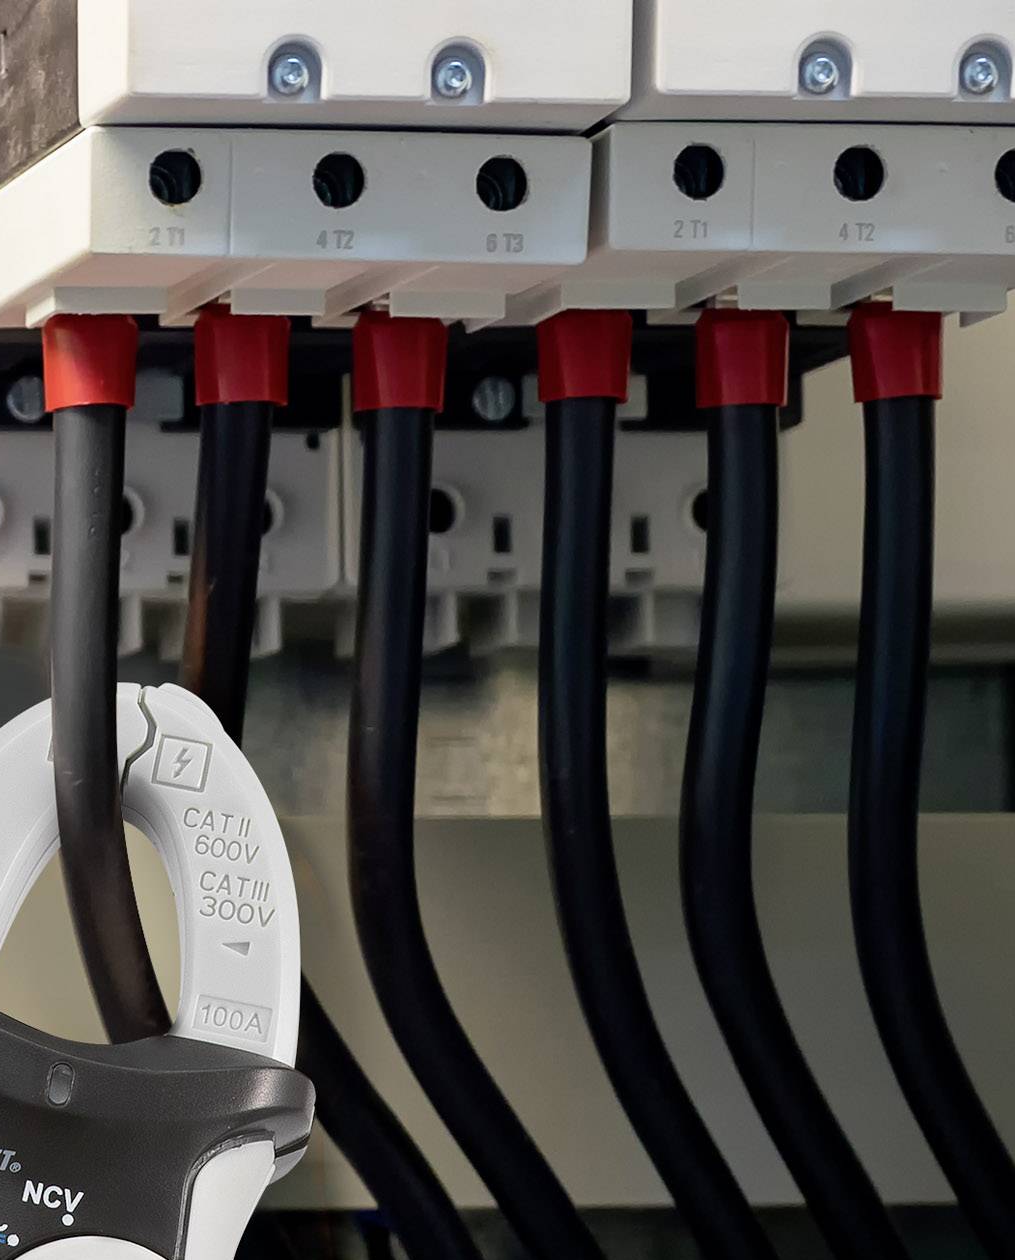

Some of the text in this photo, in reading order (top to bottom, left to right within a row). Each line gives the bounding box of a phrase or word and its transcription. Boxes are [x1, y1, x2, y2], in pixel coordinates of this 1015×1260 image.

[150, 227, 184, 247] 2 T1
[674, 220, 708, 239] 2 T1
[839, 223, 875, 242] 4 T2
[316, 230, 355, 250] 4 T2
[502, 234, 524, 253] T3
[194, 834, 261, 865] 600V
[199, 895, 275, 928] 300V
[201, 1002, 264, 1035] 100A
[21, 1179, 85, 1213] NCV
